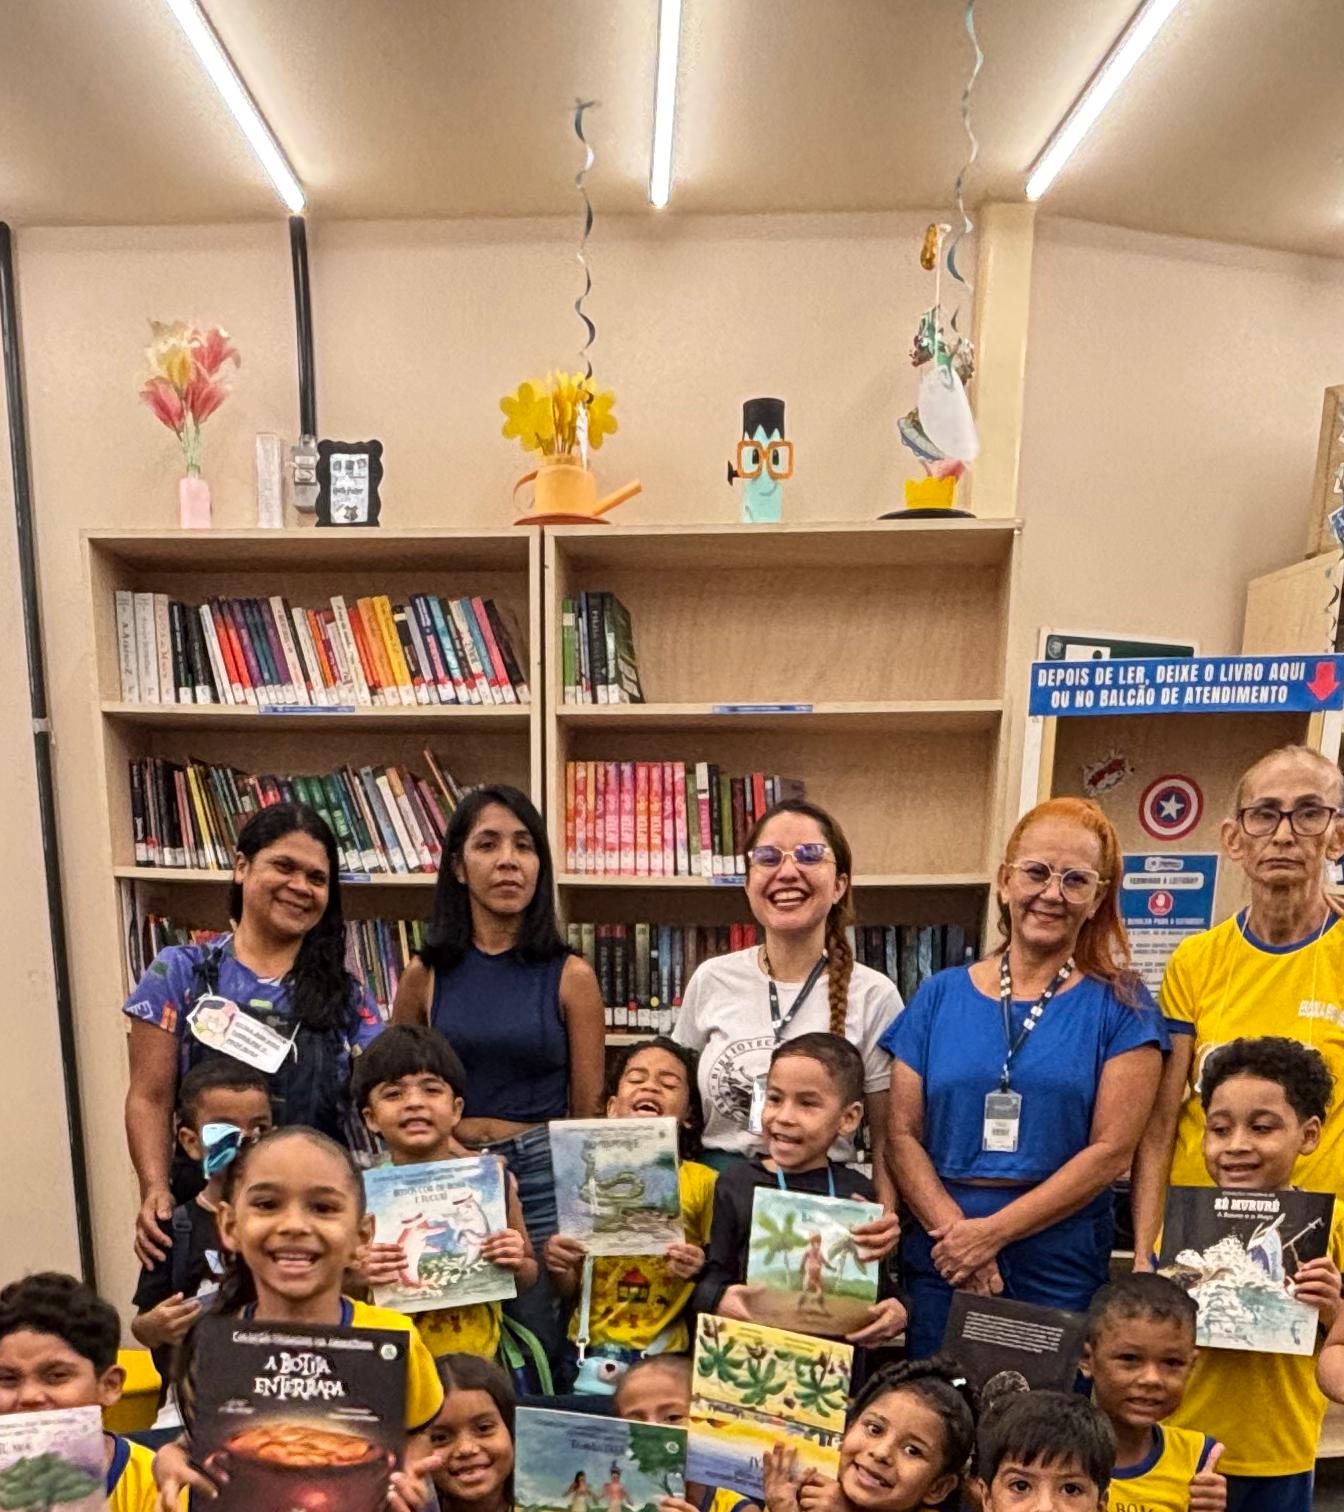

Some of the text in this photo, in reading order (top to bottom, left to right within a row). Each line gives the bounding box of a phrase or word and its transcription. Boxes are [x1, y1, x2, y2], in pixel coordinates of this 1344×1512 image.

[1038, 662, 1306, 687] DEPOIS DE LER, DEIXE O LIVRO AQUI
[1051, 684, 1289, 709] OU NO BALCÃO DE ATENDIMENTO
[280, 1352, 332, 1379] BOTIJA
